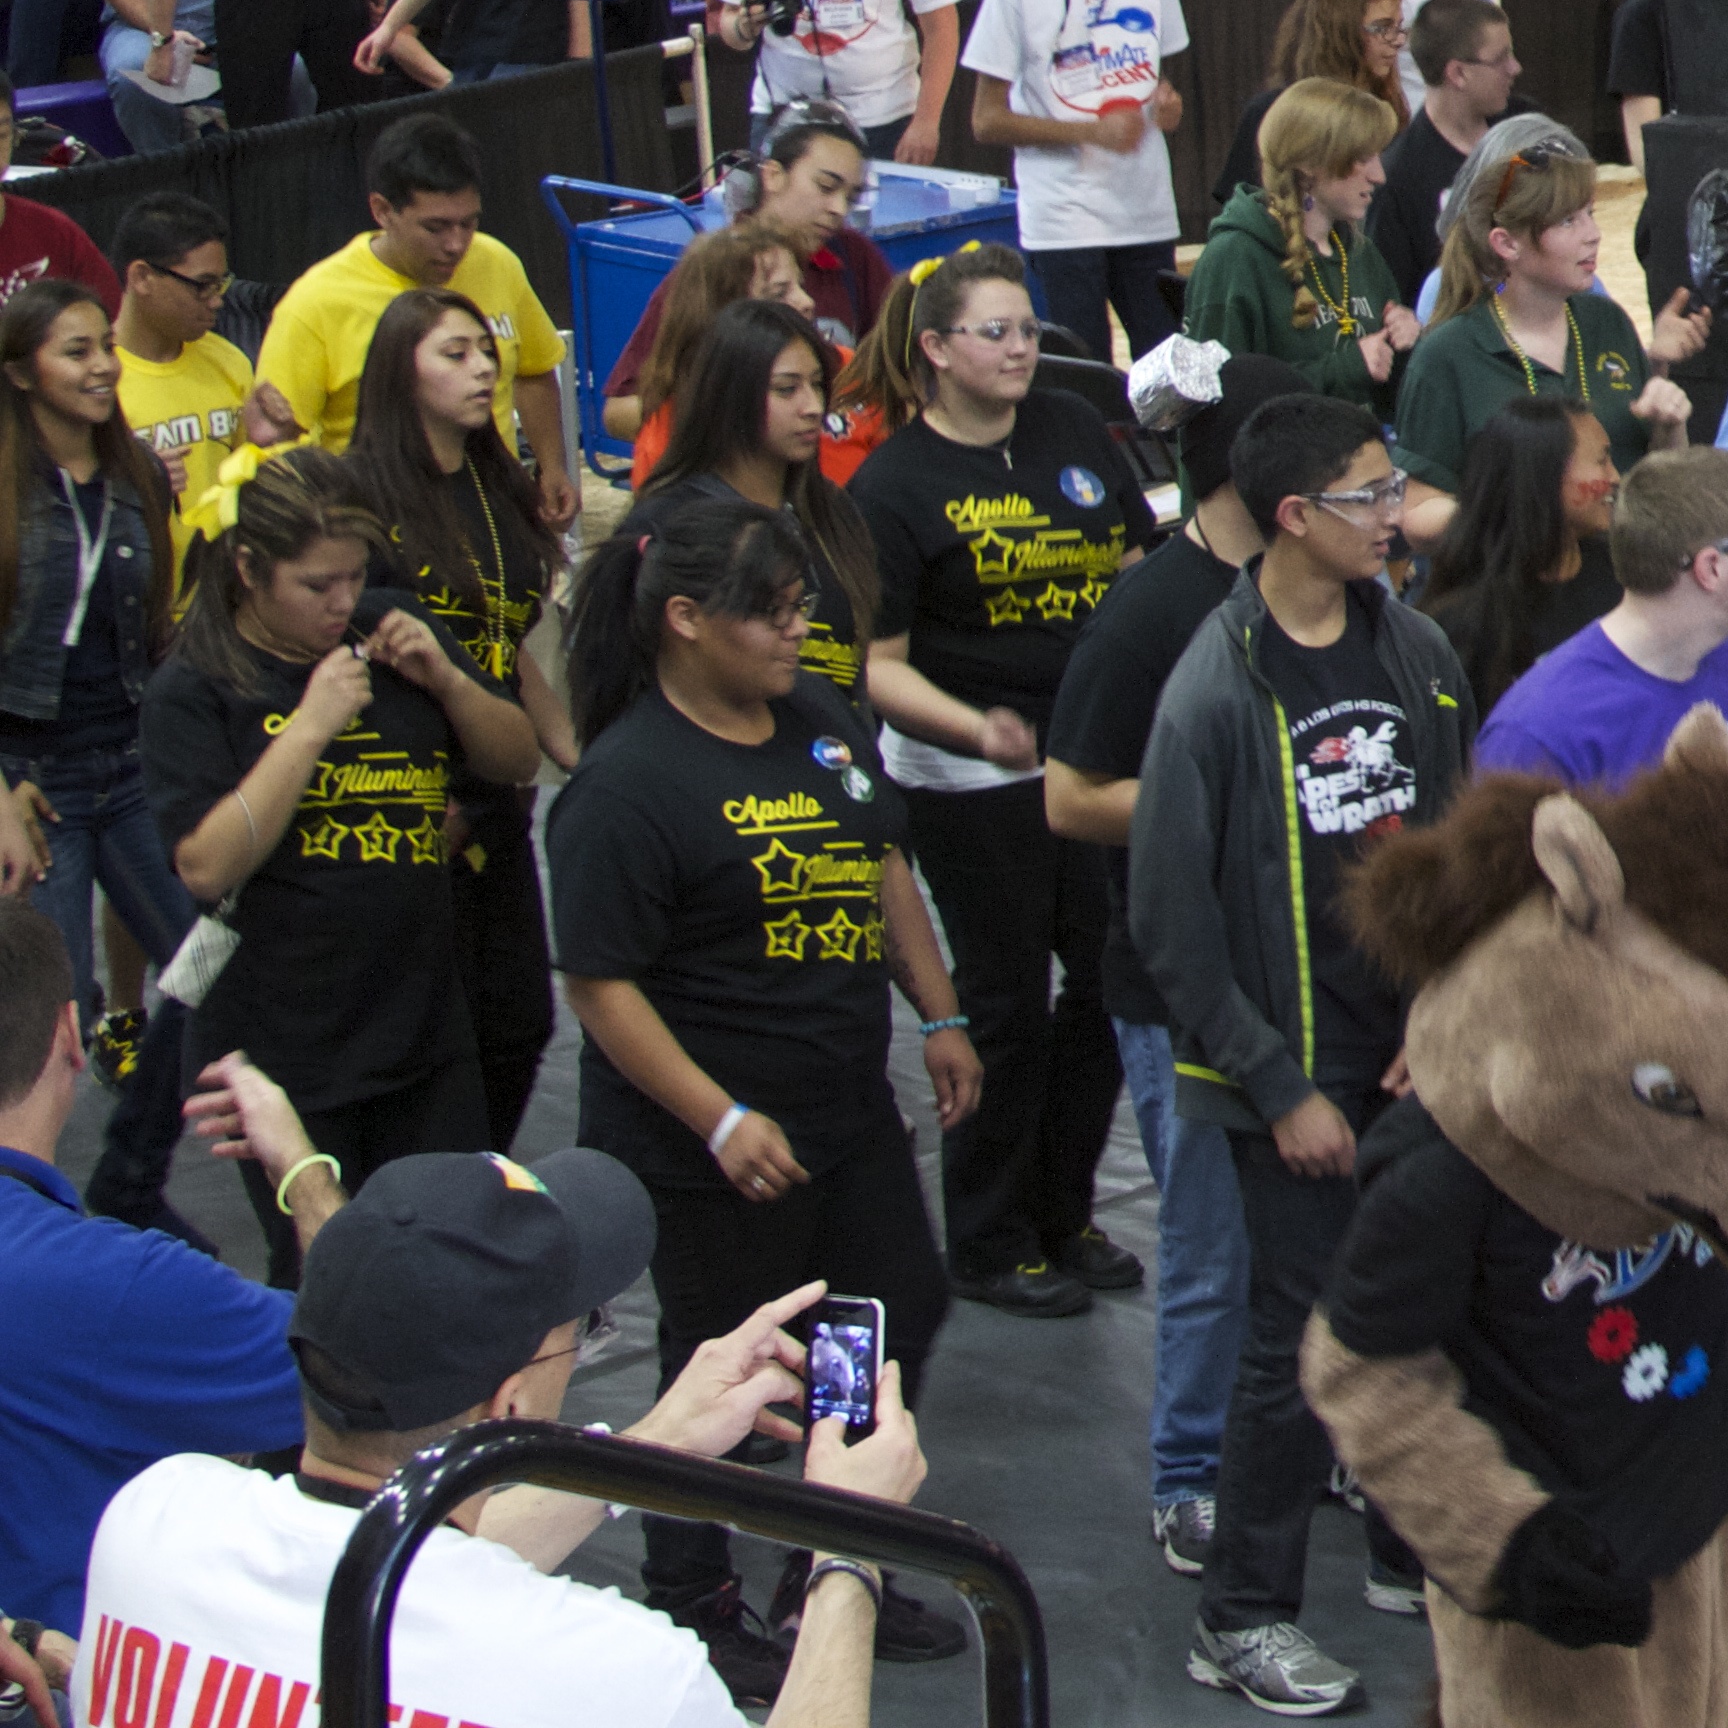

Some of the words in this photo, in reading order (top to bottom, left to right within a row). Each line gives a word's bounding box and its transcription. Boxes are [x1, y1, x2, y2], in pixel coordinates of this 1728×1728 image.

[945, 493, 1035, 529] Apollo
[723, 791, 823, 828] Apollo
[1308, 785, 1416, 833] WRATH
